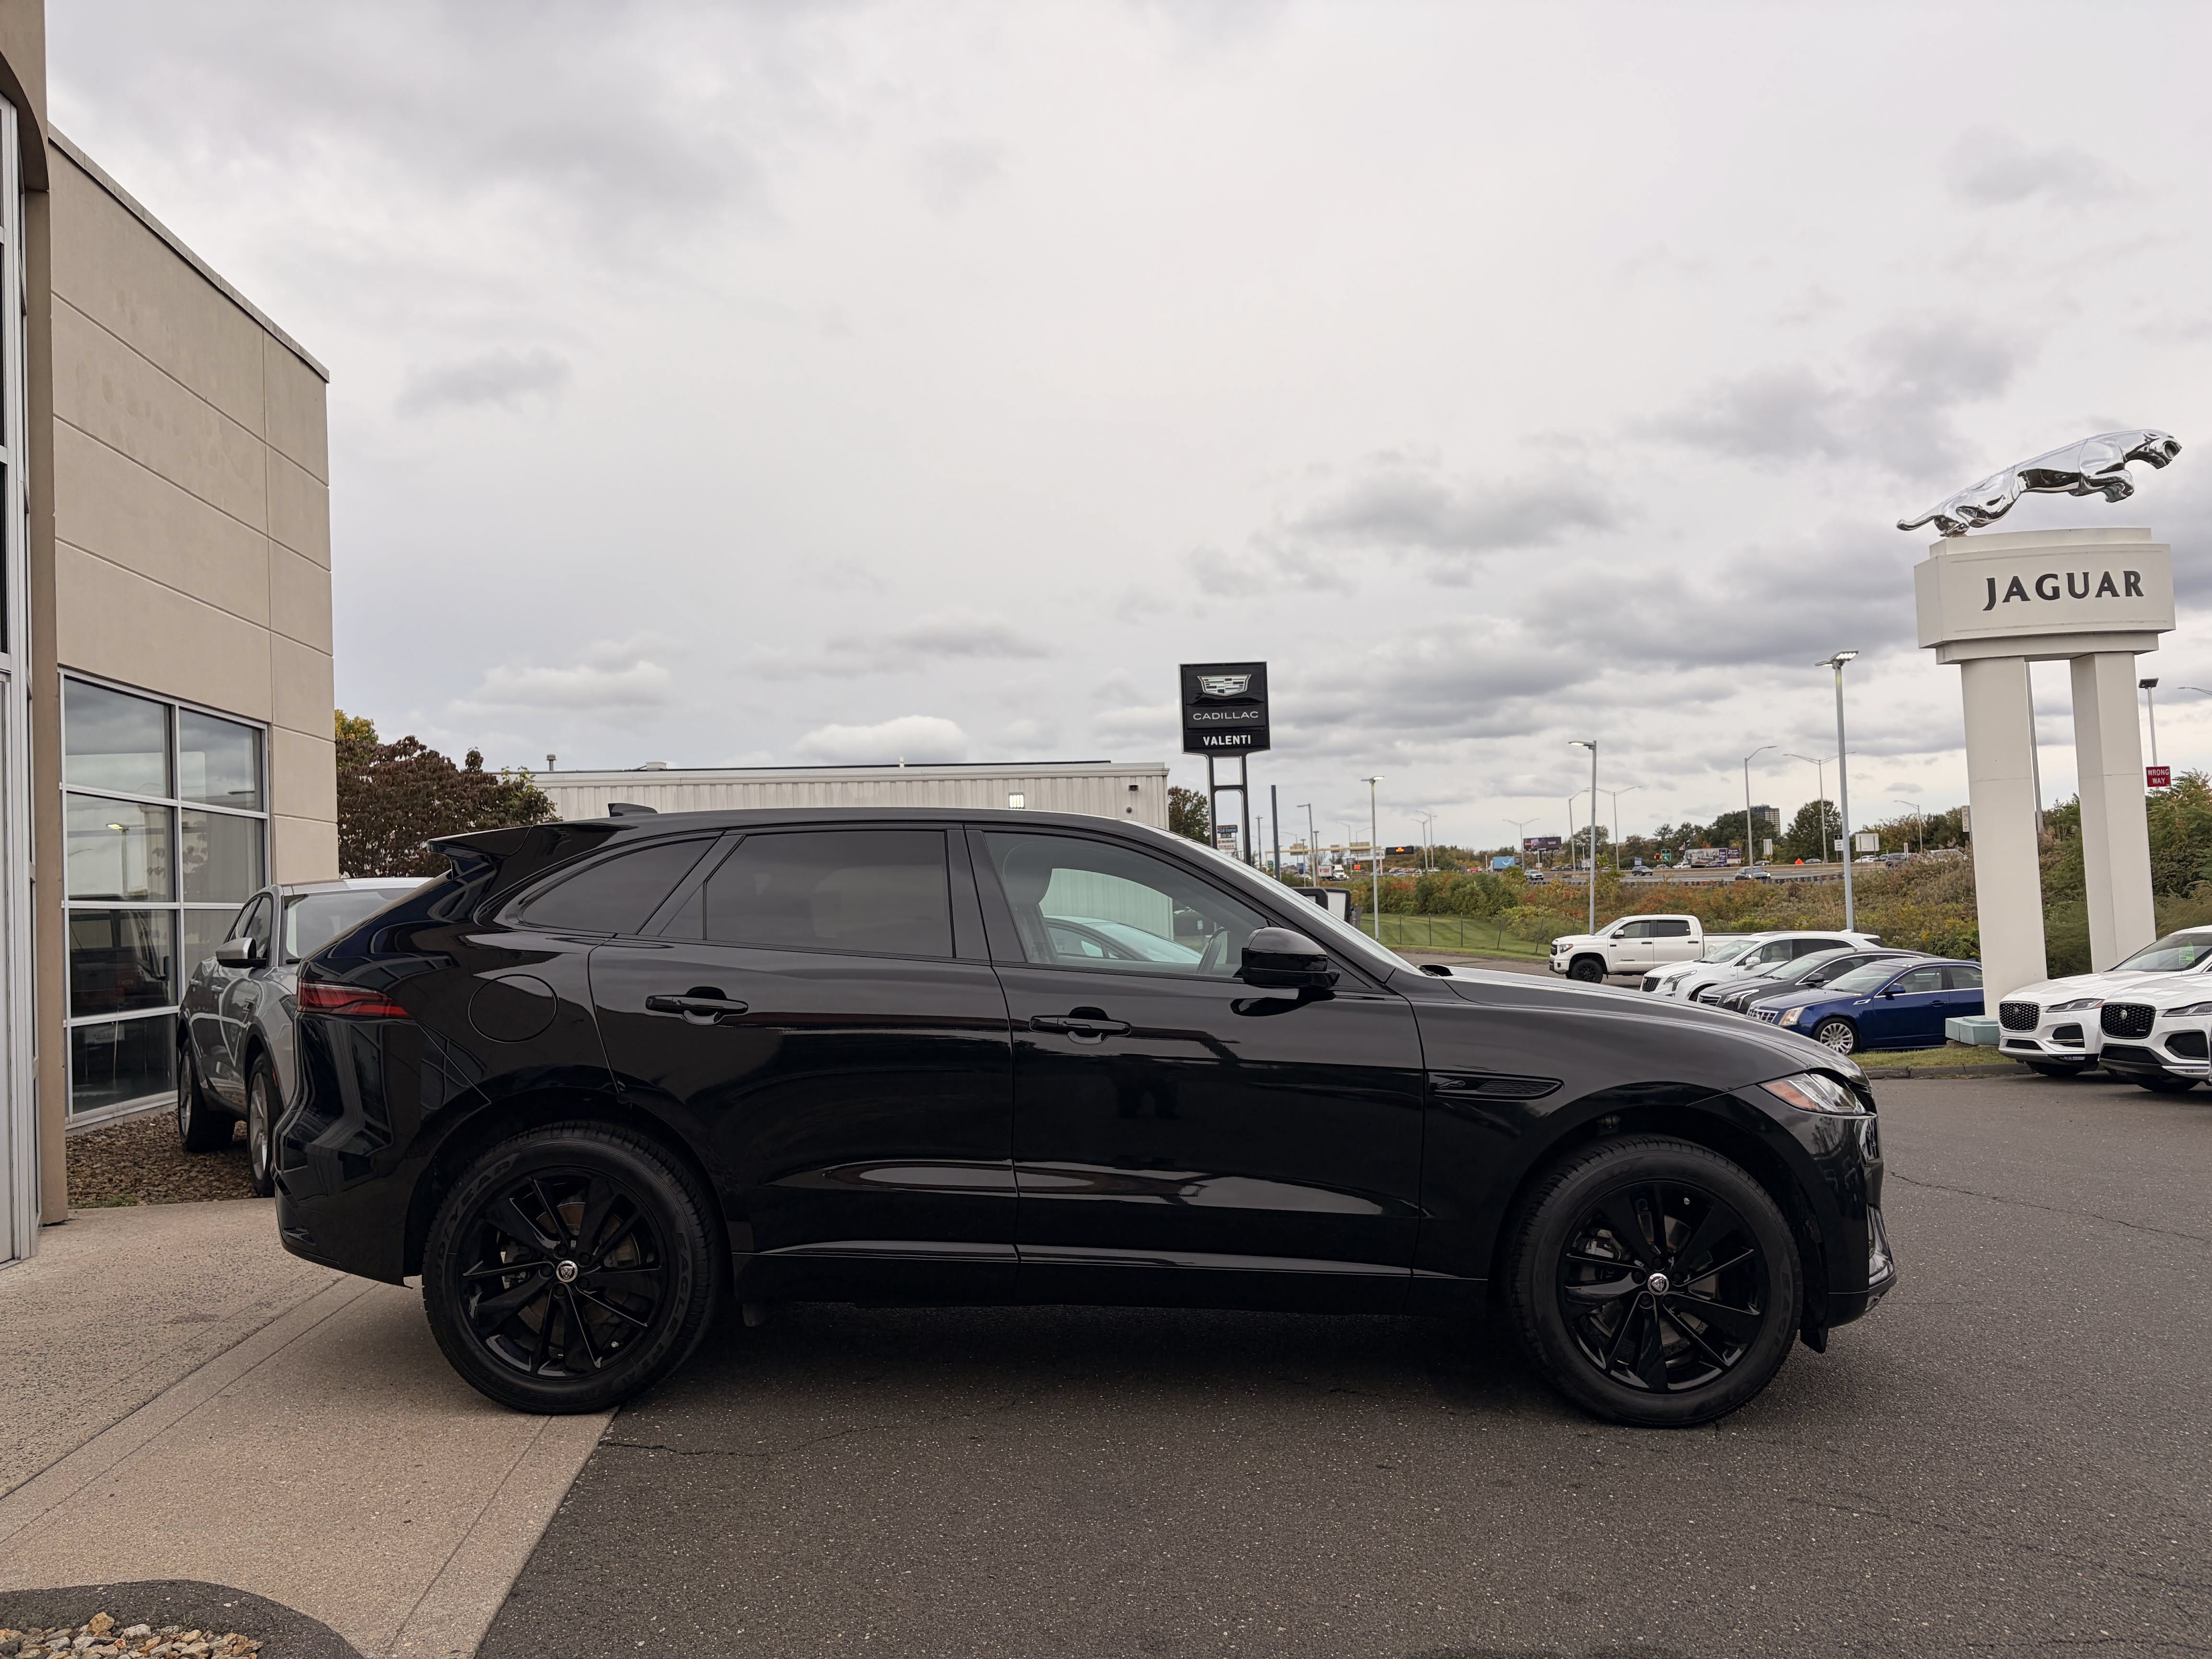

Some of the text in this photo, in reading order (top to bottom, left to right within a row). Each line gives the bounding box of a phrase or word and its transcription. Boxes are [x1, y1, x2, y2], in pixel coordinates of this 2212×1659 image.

[1983, 570, 2144, 611] JAGUAR
[1193, 711, 1259, 720] CADILLAC
[1203, 735, 1252, 746] VALENTI
